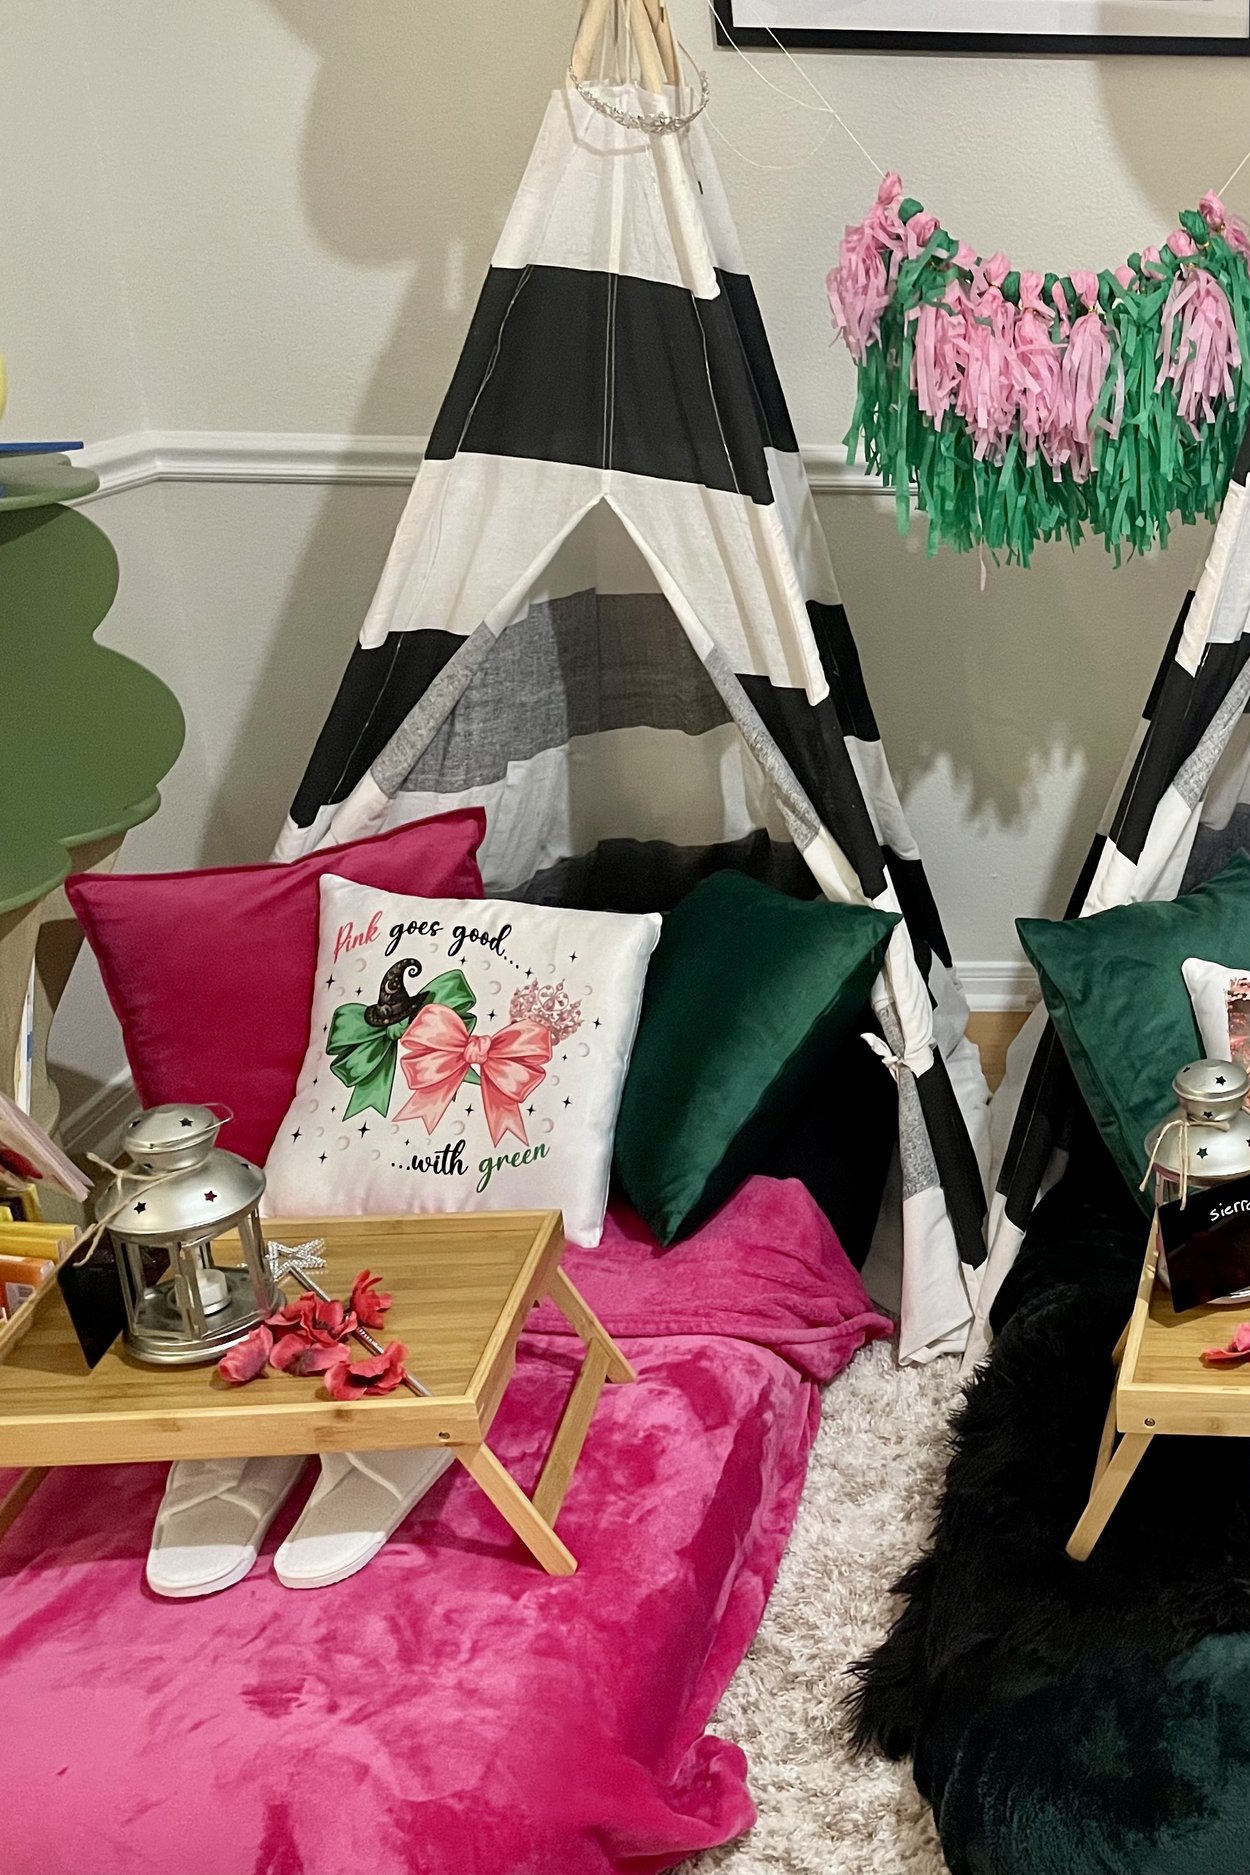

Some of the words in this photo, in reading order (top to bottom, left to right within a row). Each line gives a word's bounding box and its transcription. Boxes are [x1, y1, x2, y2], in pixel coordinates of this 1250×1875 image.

[334, 911, 383, 964] Pink
[385, 920, 443, 957] goes
[448, 924, 520, 969] good...
[391, 1139, 469, 1176] ...with
[476, 1143, 550, 1193] green
